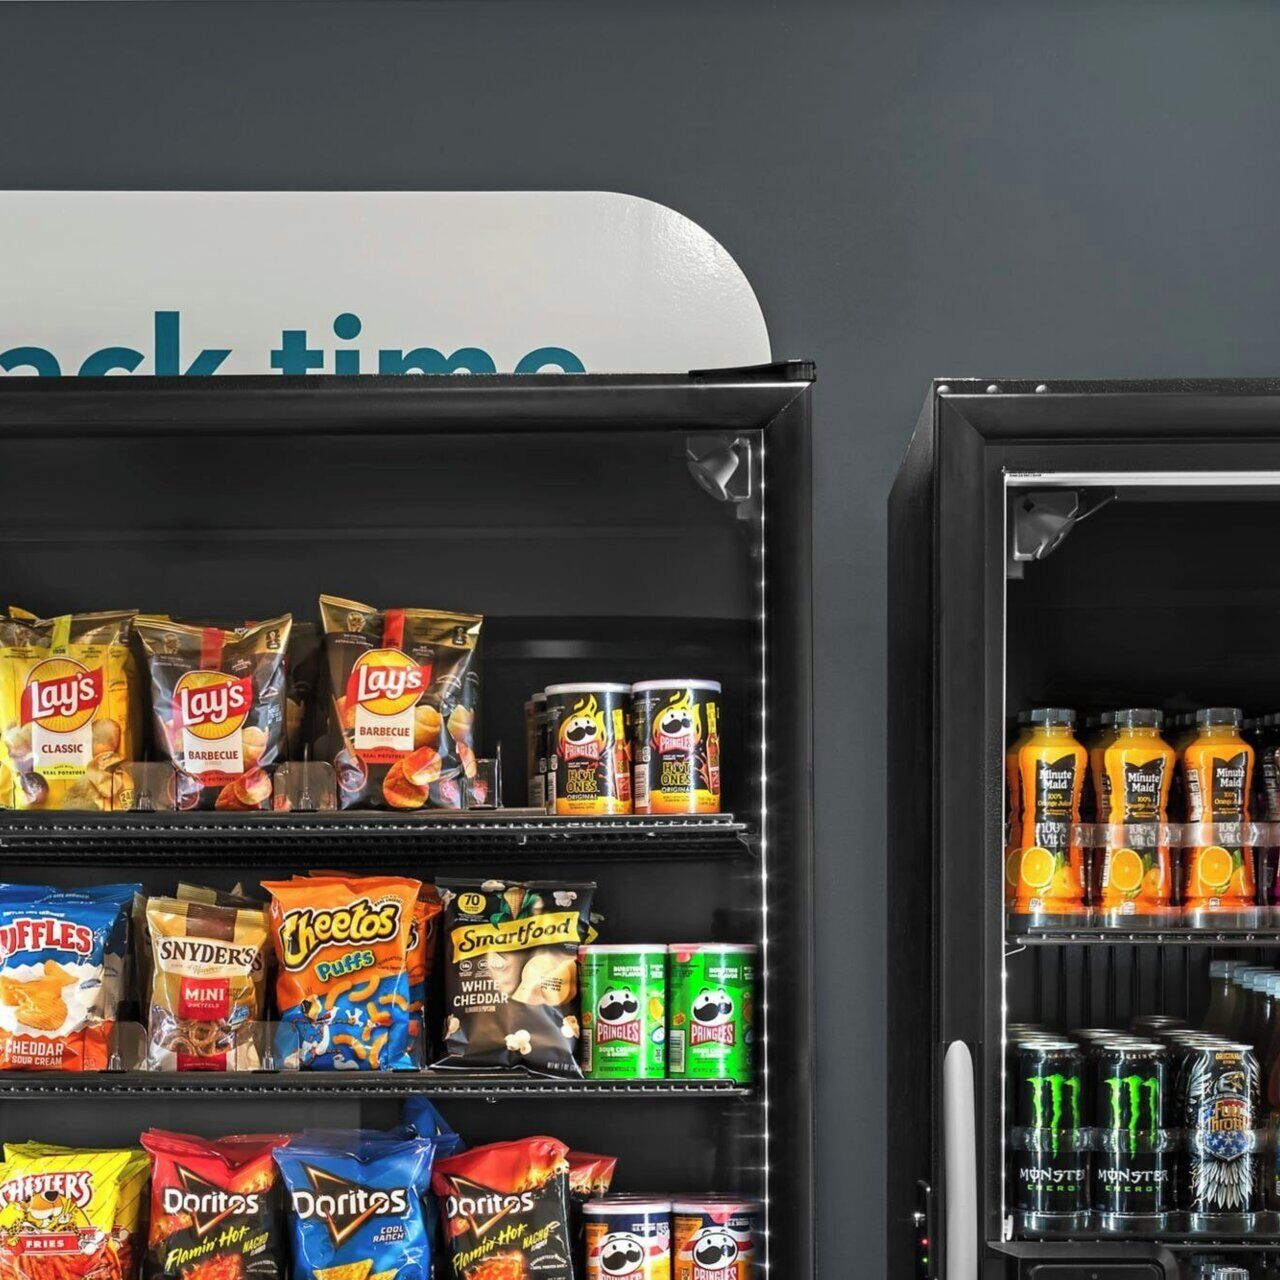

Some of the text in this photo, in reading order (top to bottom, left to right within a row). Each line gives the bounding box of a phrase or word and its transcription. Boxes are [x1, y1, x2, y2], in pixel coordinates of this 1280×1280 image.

[358, 665, 422, 701] Lay's
[31, 673, 95, 719] Lay's
[181, 681, 245, 725] Lay's
[360, 726, 410, 737] BARBECUE
[41, 743, 84, 754] CLASSIC
[188, 750, 239, 760] BARBECUE
[564, 743, 599, 761] PRINGLES
[1043, 779, 1068, 789] Maid
[1128, 772, 1160, 792] Minute Maid
[464, 894, 480, 906] 70
[282, 899, 401, 968] Cheetos
[458, 917, 571, 953] Smartfood
[160, 940, 256, 967] SNYDER'S
[316, 949, 375, 981] Puffs
[184, 988, 225, 1001] MINI
[461, 979, 500, 992] WHITE
[453, 992, 509, 1007] CHEDDAR
[597, 1022, 640, 1042] PRINGLES
[691, 1023, 733, 1044] PRINGLES
[5, 1039, 64, 1056] CHEDDAR
[11, 1056, 63, 1066] SOUR CREAM
[1098, 1167, 1169, 1183] MONSTER
[164, 1188, 259, 1215] Doritos
[291, 1187, 407, 1220] Doritos
[446, 1192, 535, 1219] Doritos
[26, 1239, 64, 1248] FRIES
[372, 1225, 406, 1243] COOL RANCH
[165, 1236, 218, 1272] Flamin'
[219, 1225, 251, 1248] Hot
